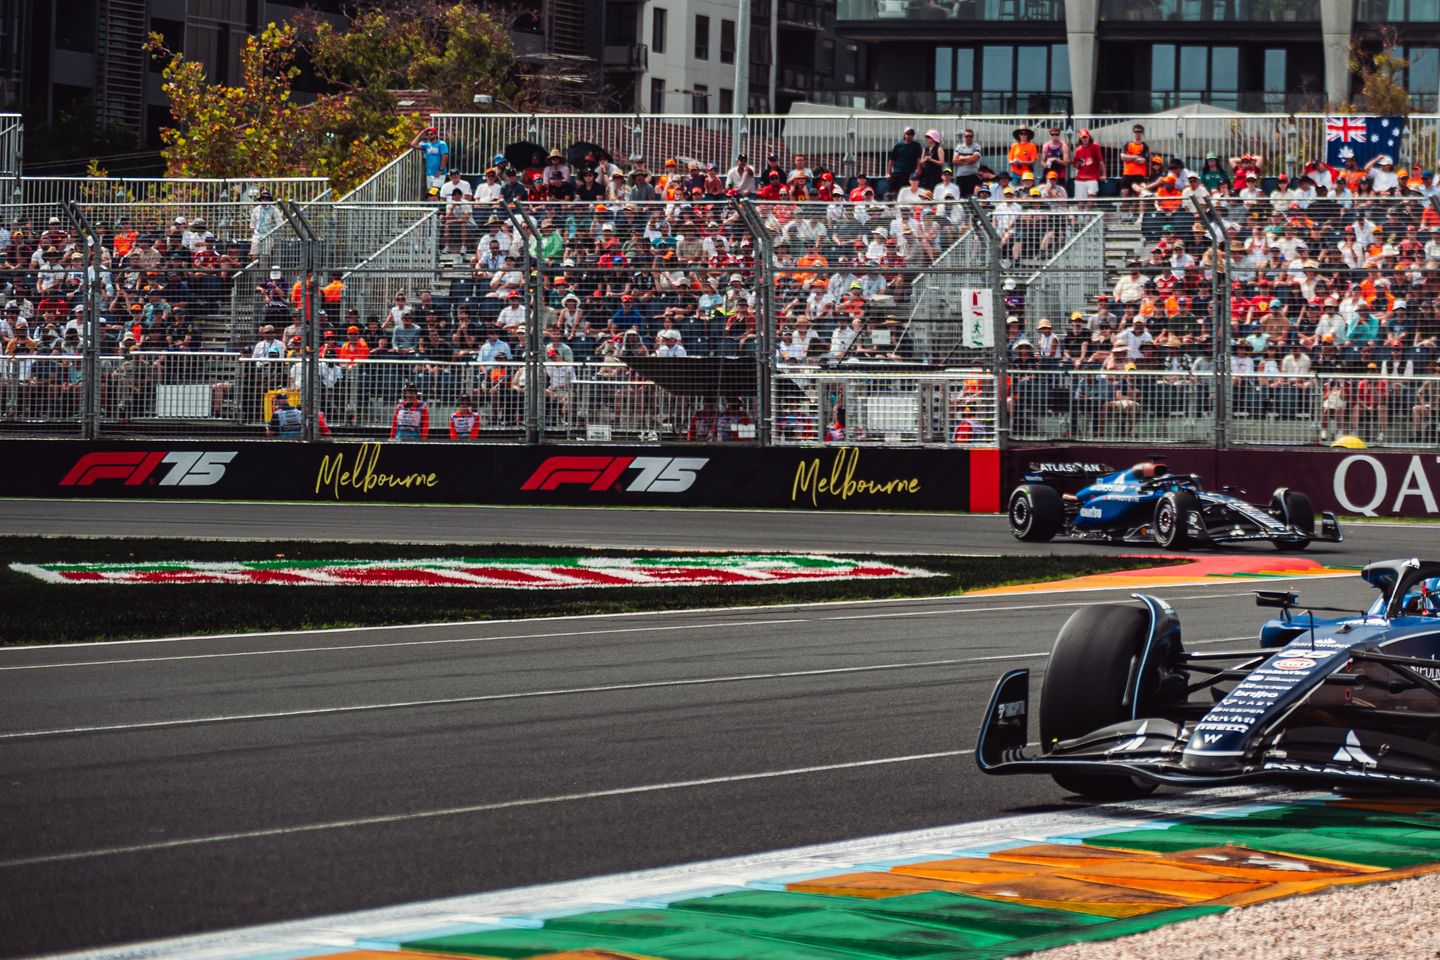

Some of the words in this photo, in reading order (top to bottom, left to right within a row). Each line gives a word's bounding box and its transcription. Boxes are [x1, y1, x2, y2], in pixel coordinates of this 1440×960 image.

[58, 451, 167, 486] F1
[159, 451, 239, 486] 75
[315, 440, 440, 500] Melbourne
[519, 456, 635, 491] F1
[625, 457, 711, 493] 75
[792, 446, 921, 507] Melbourne
[1040, 463, 1101, 472] ATLASAN
